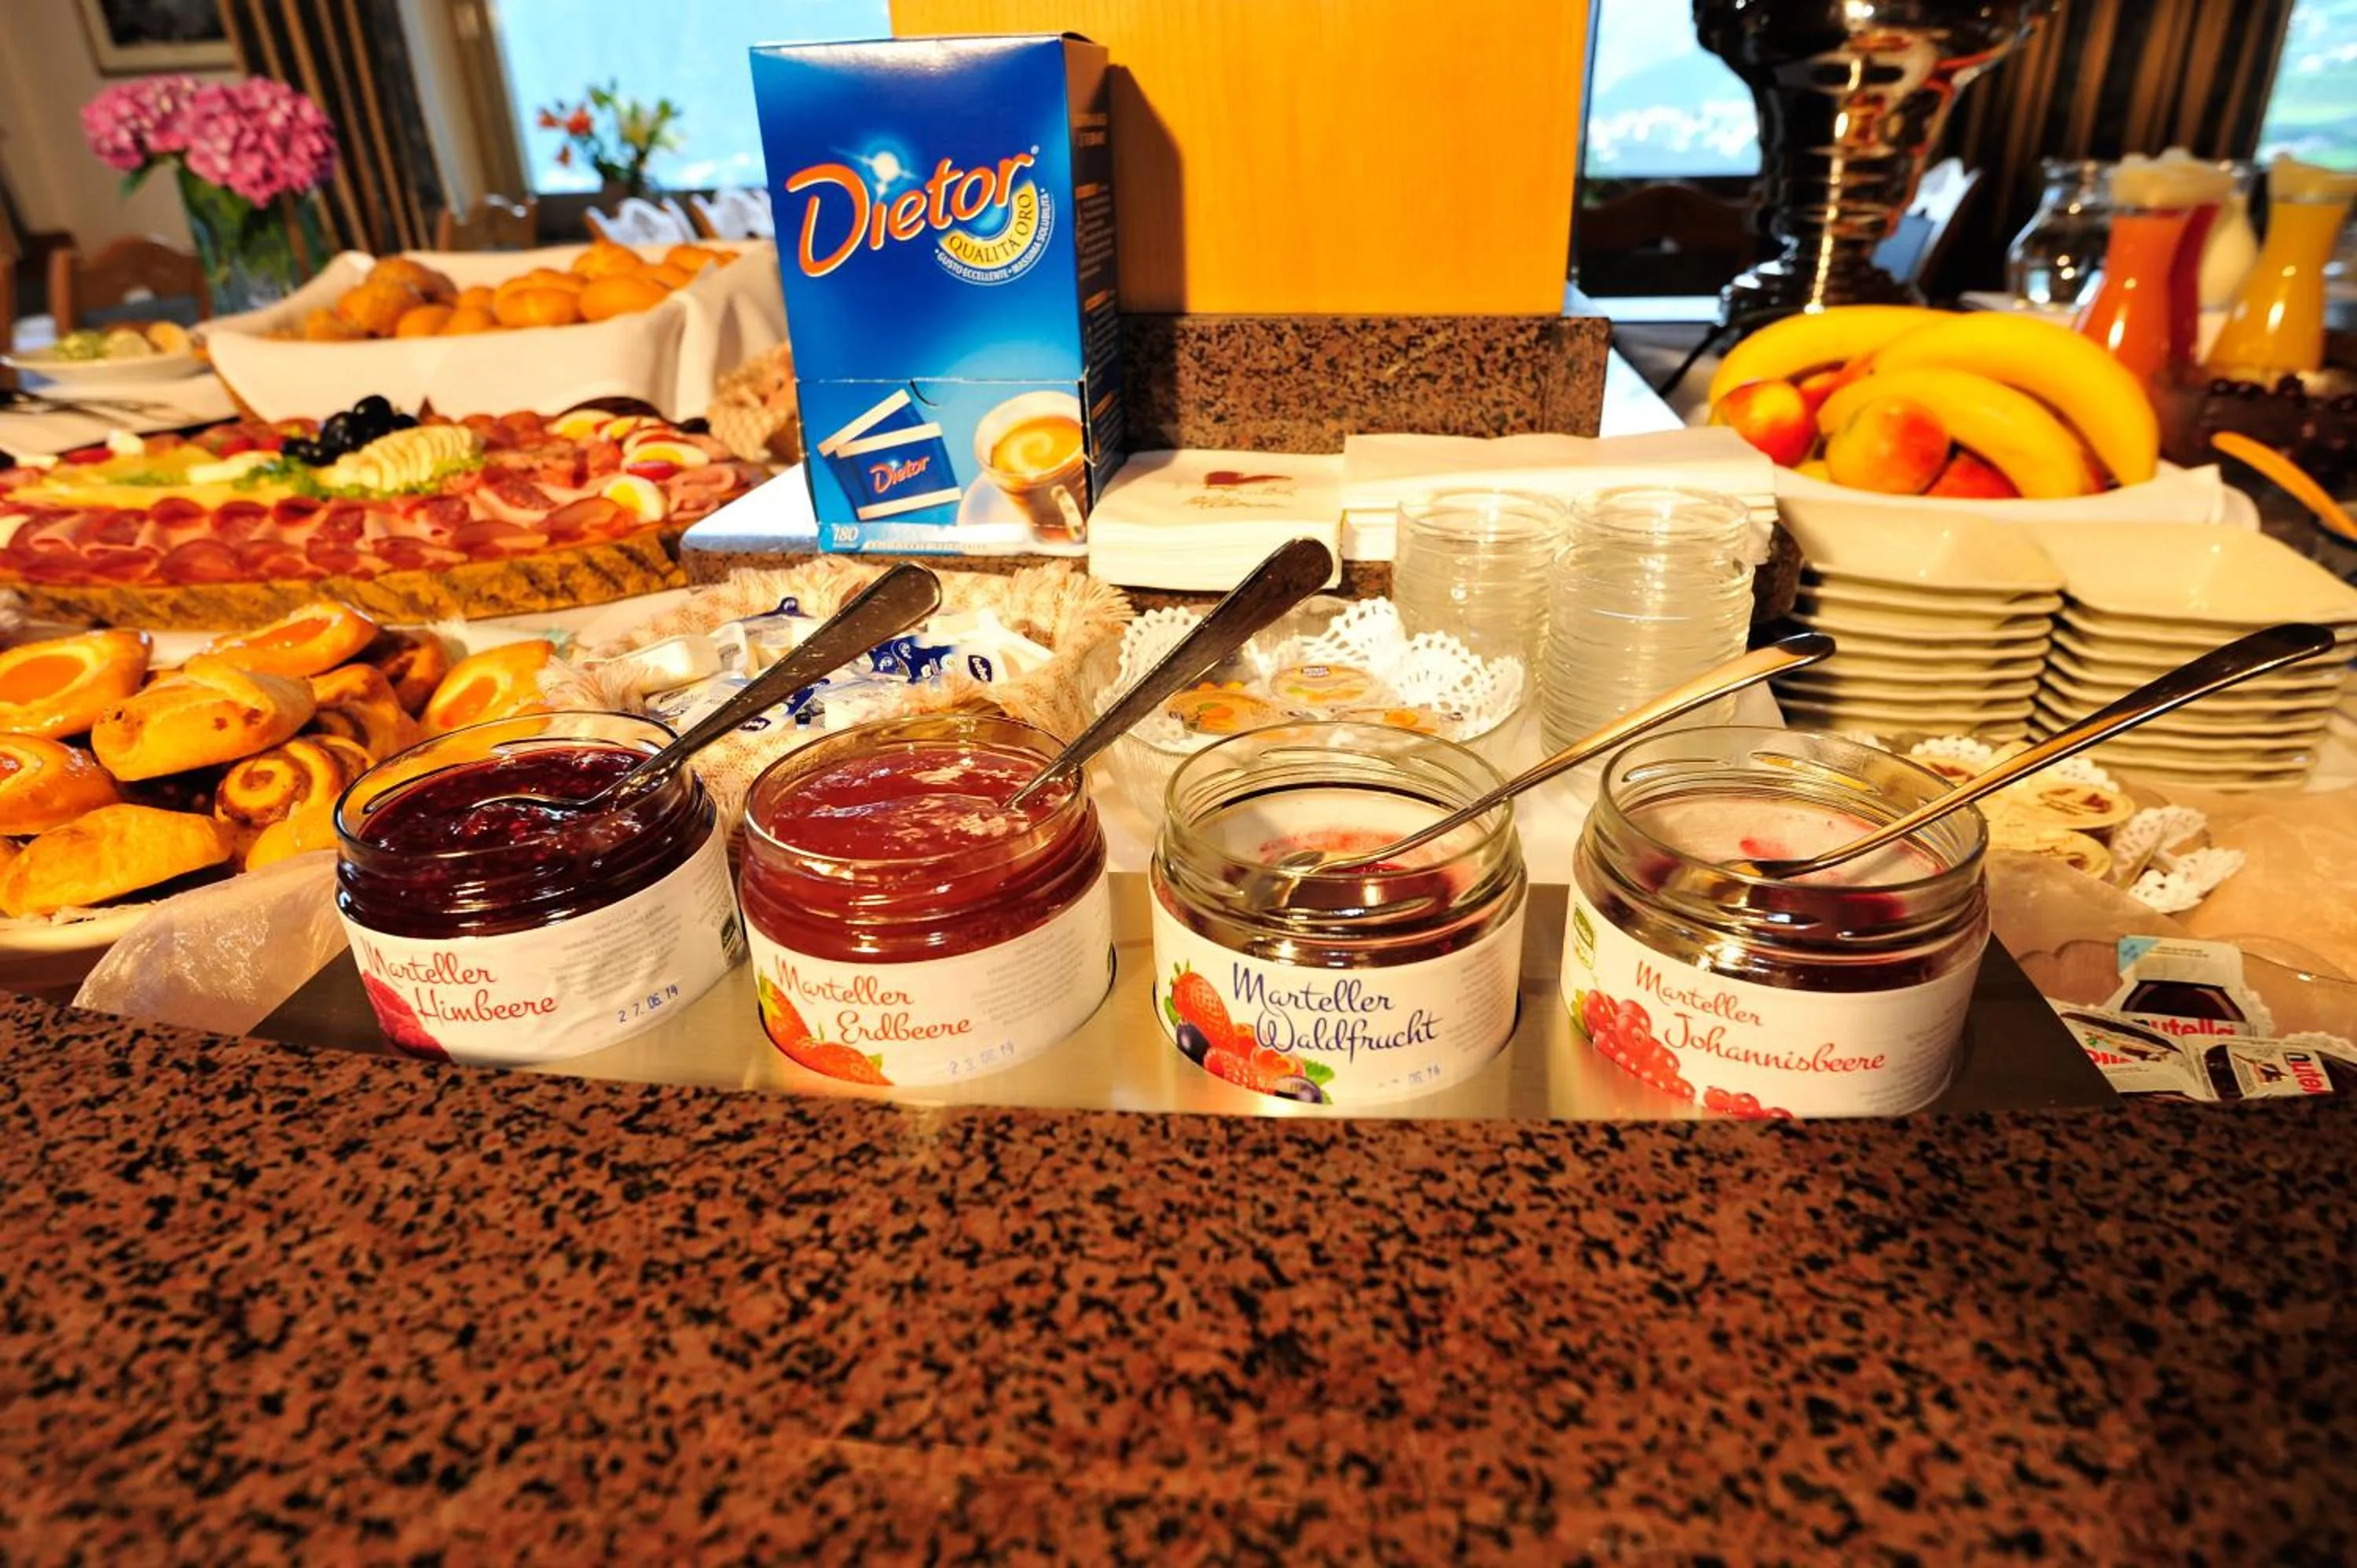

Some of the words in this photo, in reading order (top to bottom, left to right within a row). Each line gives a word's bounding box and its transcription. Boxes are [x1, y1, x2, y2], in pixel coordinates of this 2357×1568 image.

[786, 153, 1036, 277] Dietor
[1015, 193, 1033, 236] ORO
[870, 455, 930, 494] Dietor
[360, 936, 498, 988] Marteller
[775, 954, 915, 1006] Marteller
[1233, 961, 1396, 1015] Marteller
[415, 987, 558, 1028] Himbeere
[1636, 959, 1765, 1027] Marteller
[837, 1009, 973, 1043] Erdbeere
[1256, 1009, 1444, 1064] Waldfrucht
[1664, 1012, 1886, 1074] Johannisbeere
